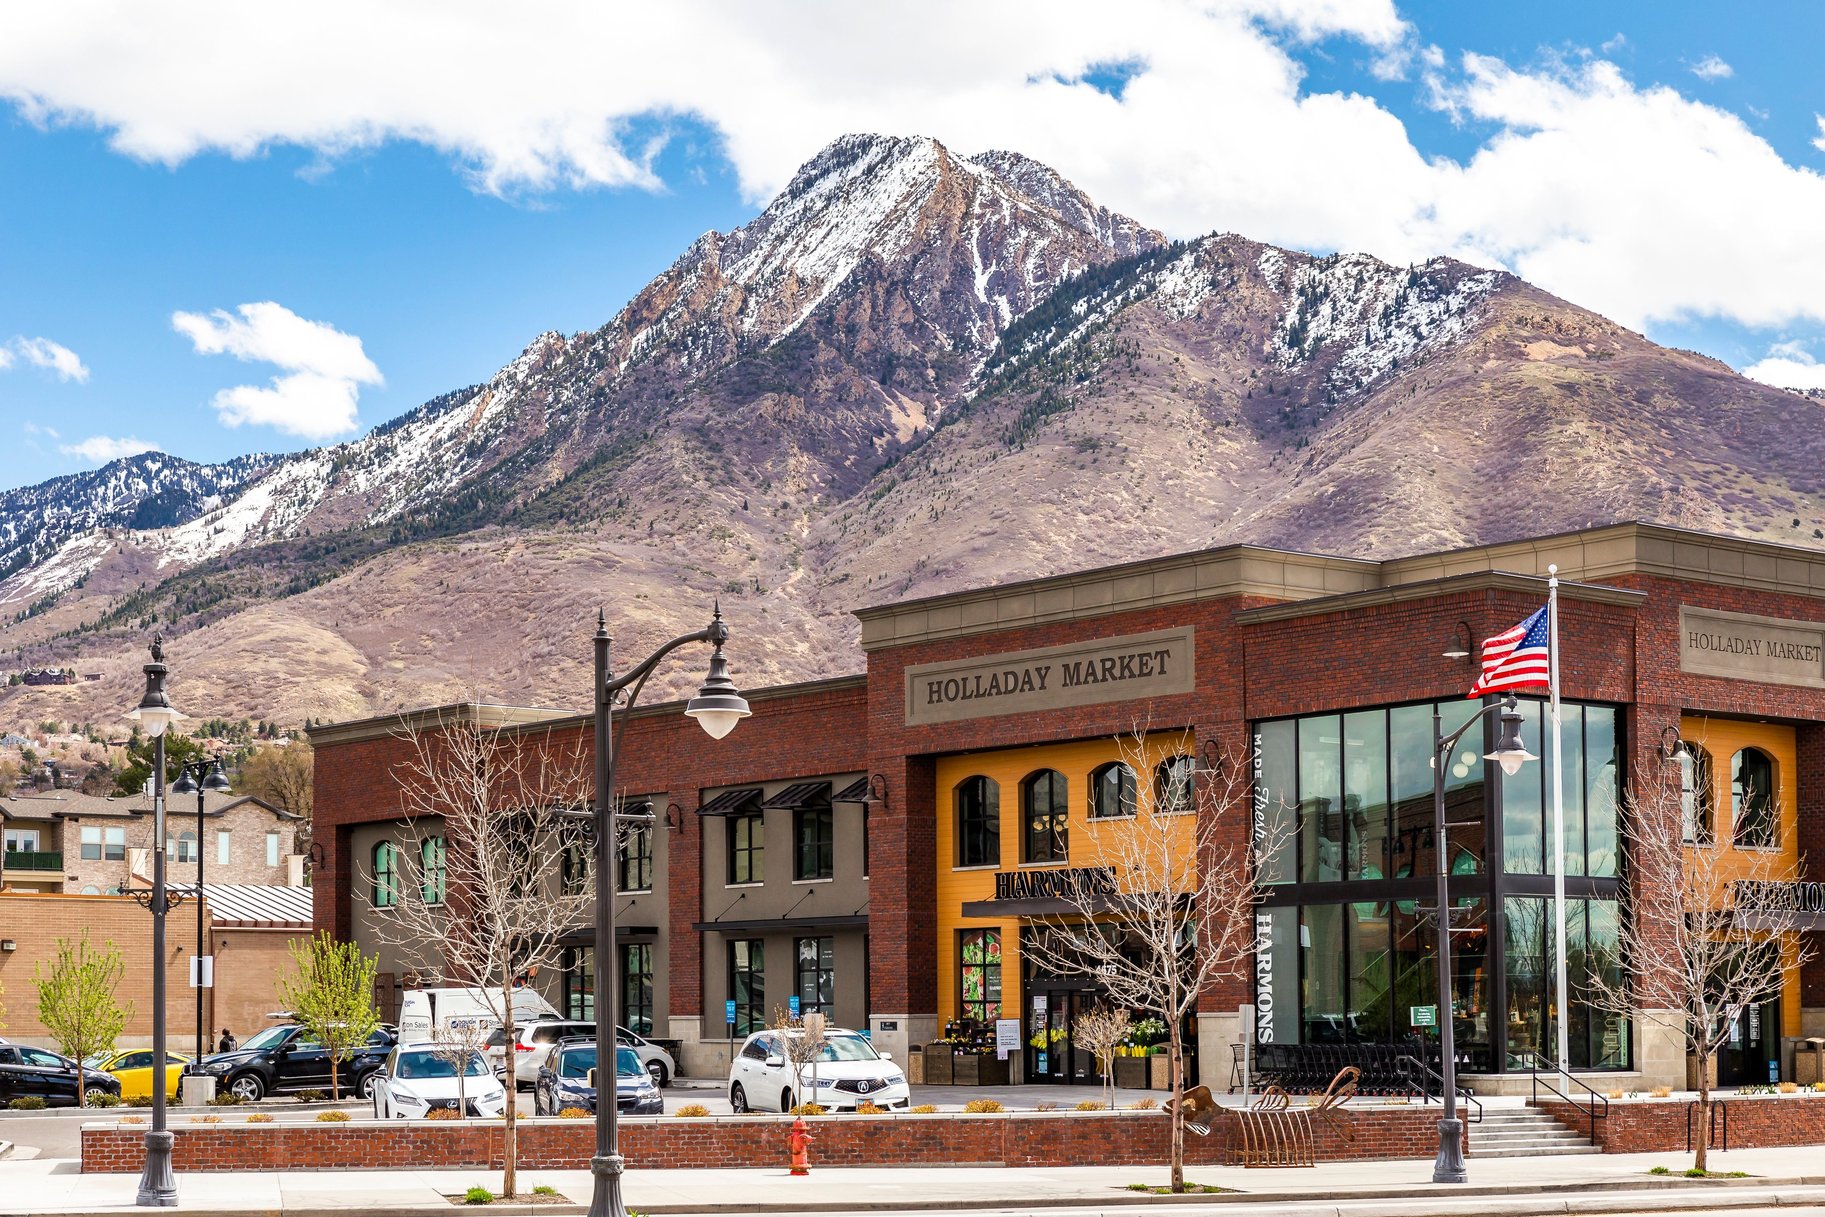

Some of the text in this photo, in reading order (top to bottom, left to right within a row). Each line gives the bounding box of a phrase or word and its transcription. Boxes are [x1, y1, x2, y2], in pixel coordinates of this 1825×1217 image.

[1688, 631, 1822, 663] HOLLADAY MARKET
[927, 649, 1171, 704] HOLLADAY MARKET
[1254, 733, 1263, 779] MADE
[1254, 787, 1269, 842] Fresh
[994, 865, 1117, 900] HARMONS
[1733, 880, 1825, 912] HARMO
[1256, 913, 1274, 1044] HARMONS
